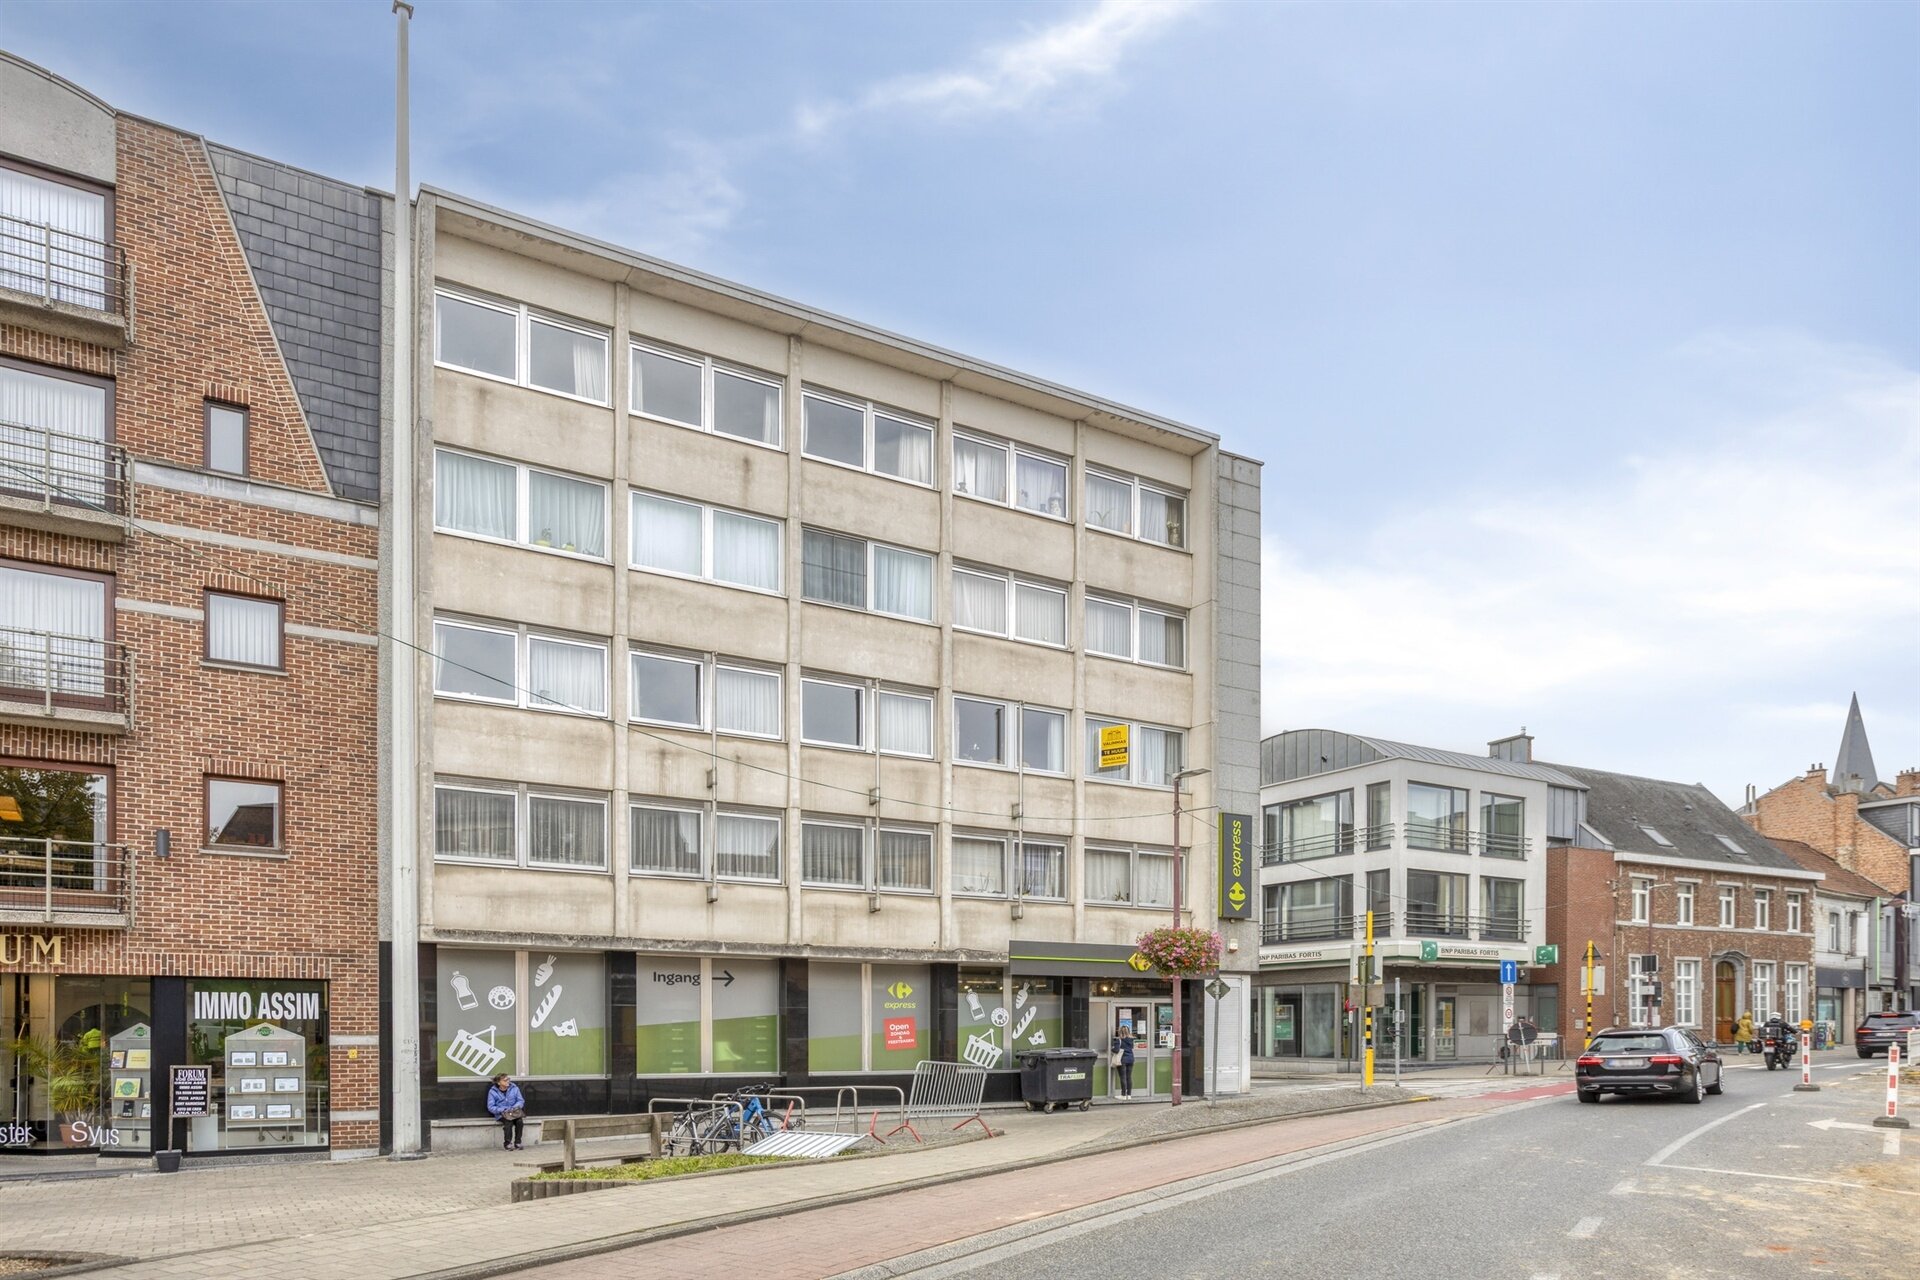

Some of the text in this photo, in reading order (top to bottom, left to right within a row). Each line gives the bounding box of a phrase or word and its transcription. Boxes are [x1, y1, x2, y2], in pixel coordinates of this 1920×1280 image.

[1232, 820, 1243, 877] express
[653, 971, 701, 986] Ingang
[194, 991, 320, 1020] IMMO ASSIM
[884, 1002, 917, 1010] express
[178, 1070, 204, 1078] FORUM
[70, 1120, 120, 1147] Syus
